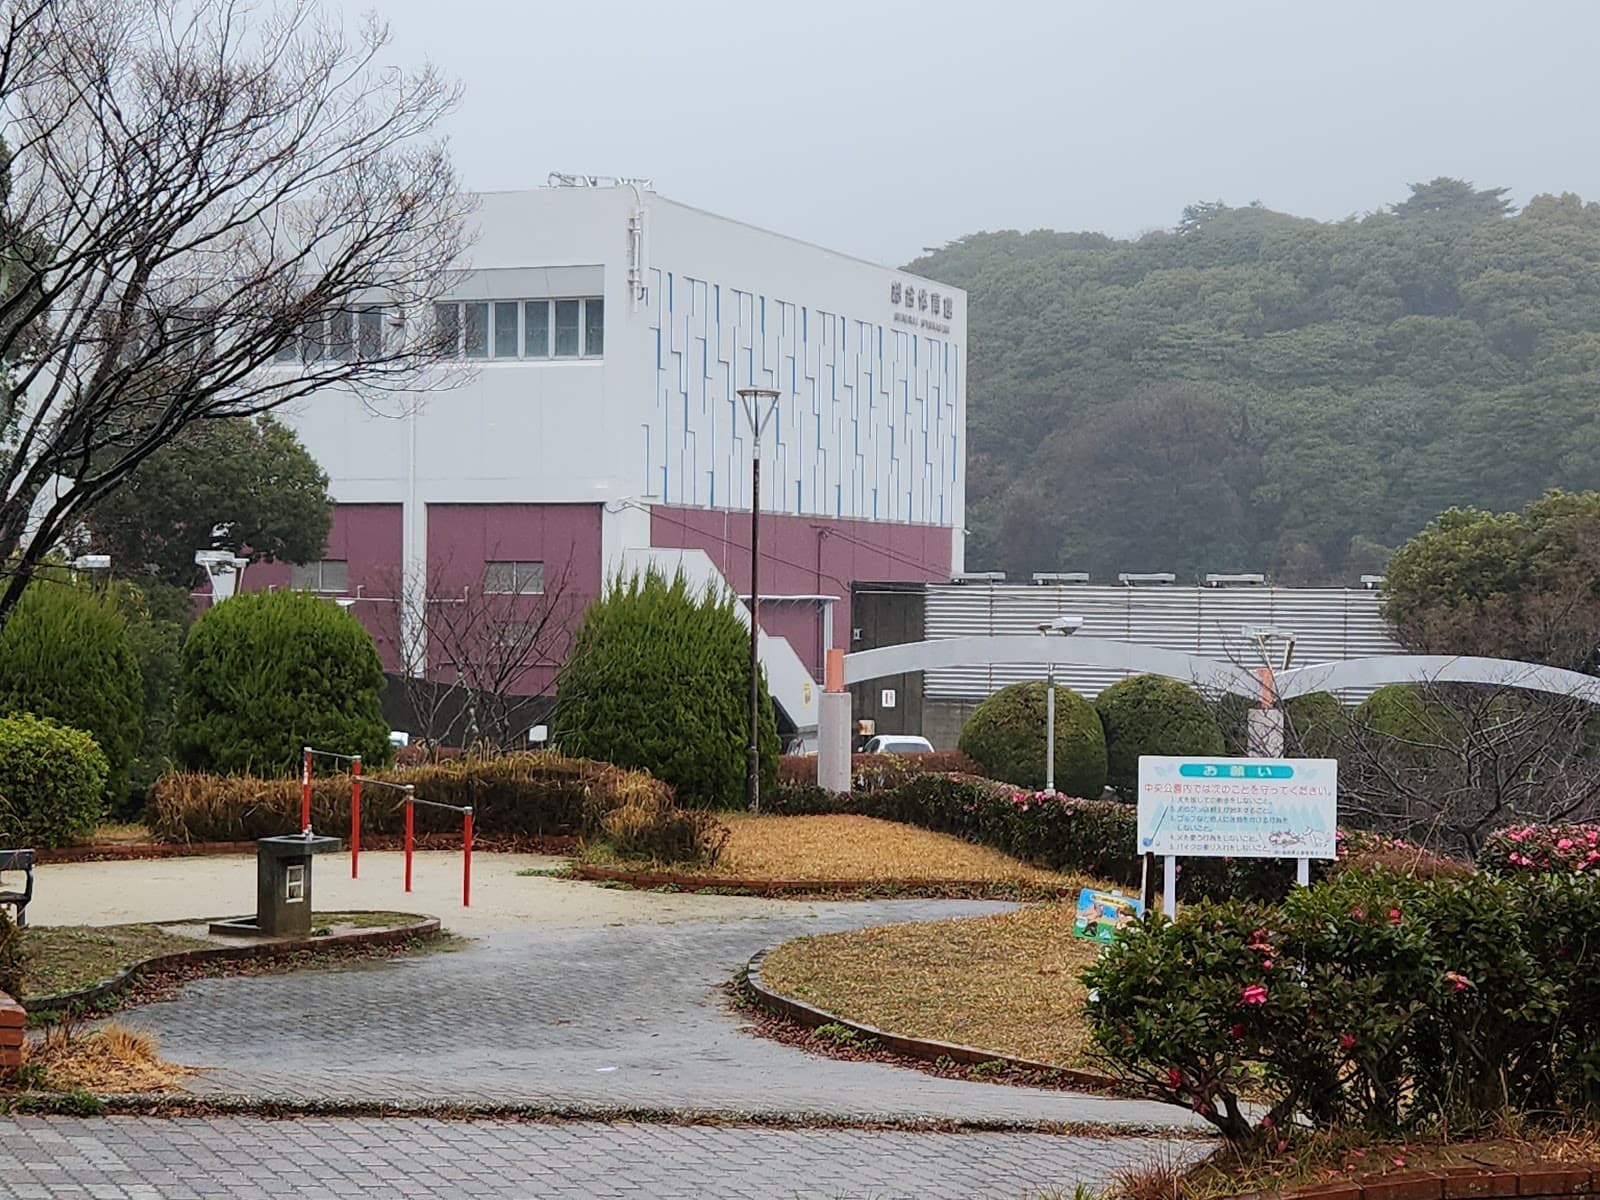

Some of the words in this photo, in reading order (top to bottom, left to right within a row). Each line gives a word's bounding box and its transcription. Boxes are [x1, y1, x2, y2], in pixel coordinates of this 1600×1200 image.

[1202, 765, 1272, 778] お願い
[1144, 783, 1332, 796] 中央公園内では次のことを守ってください。
